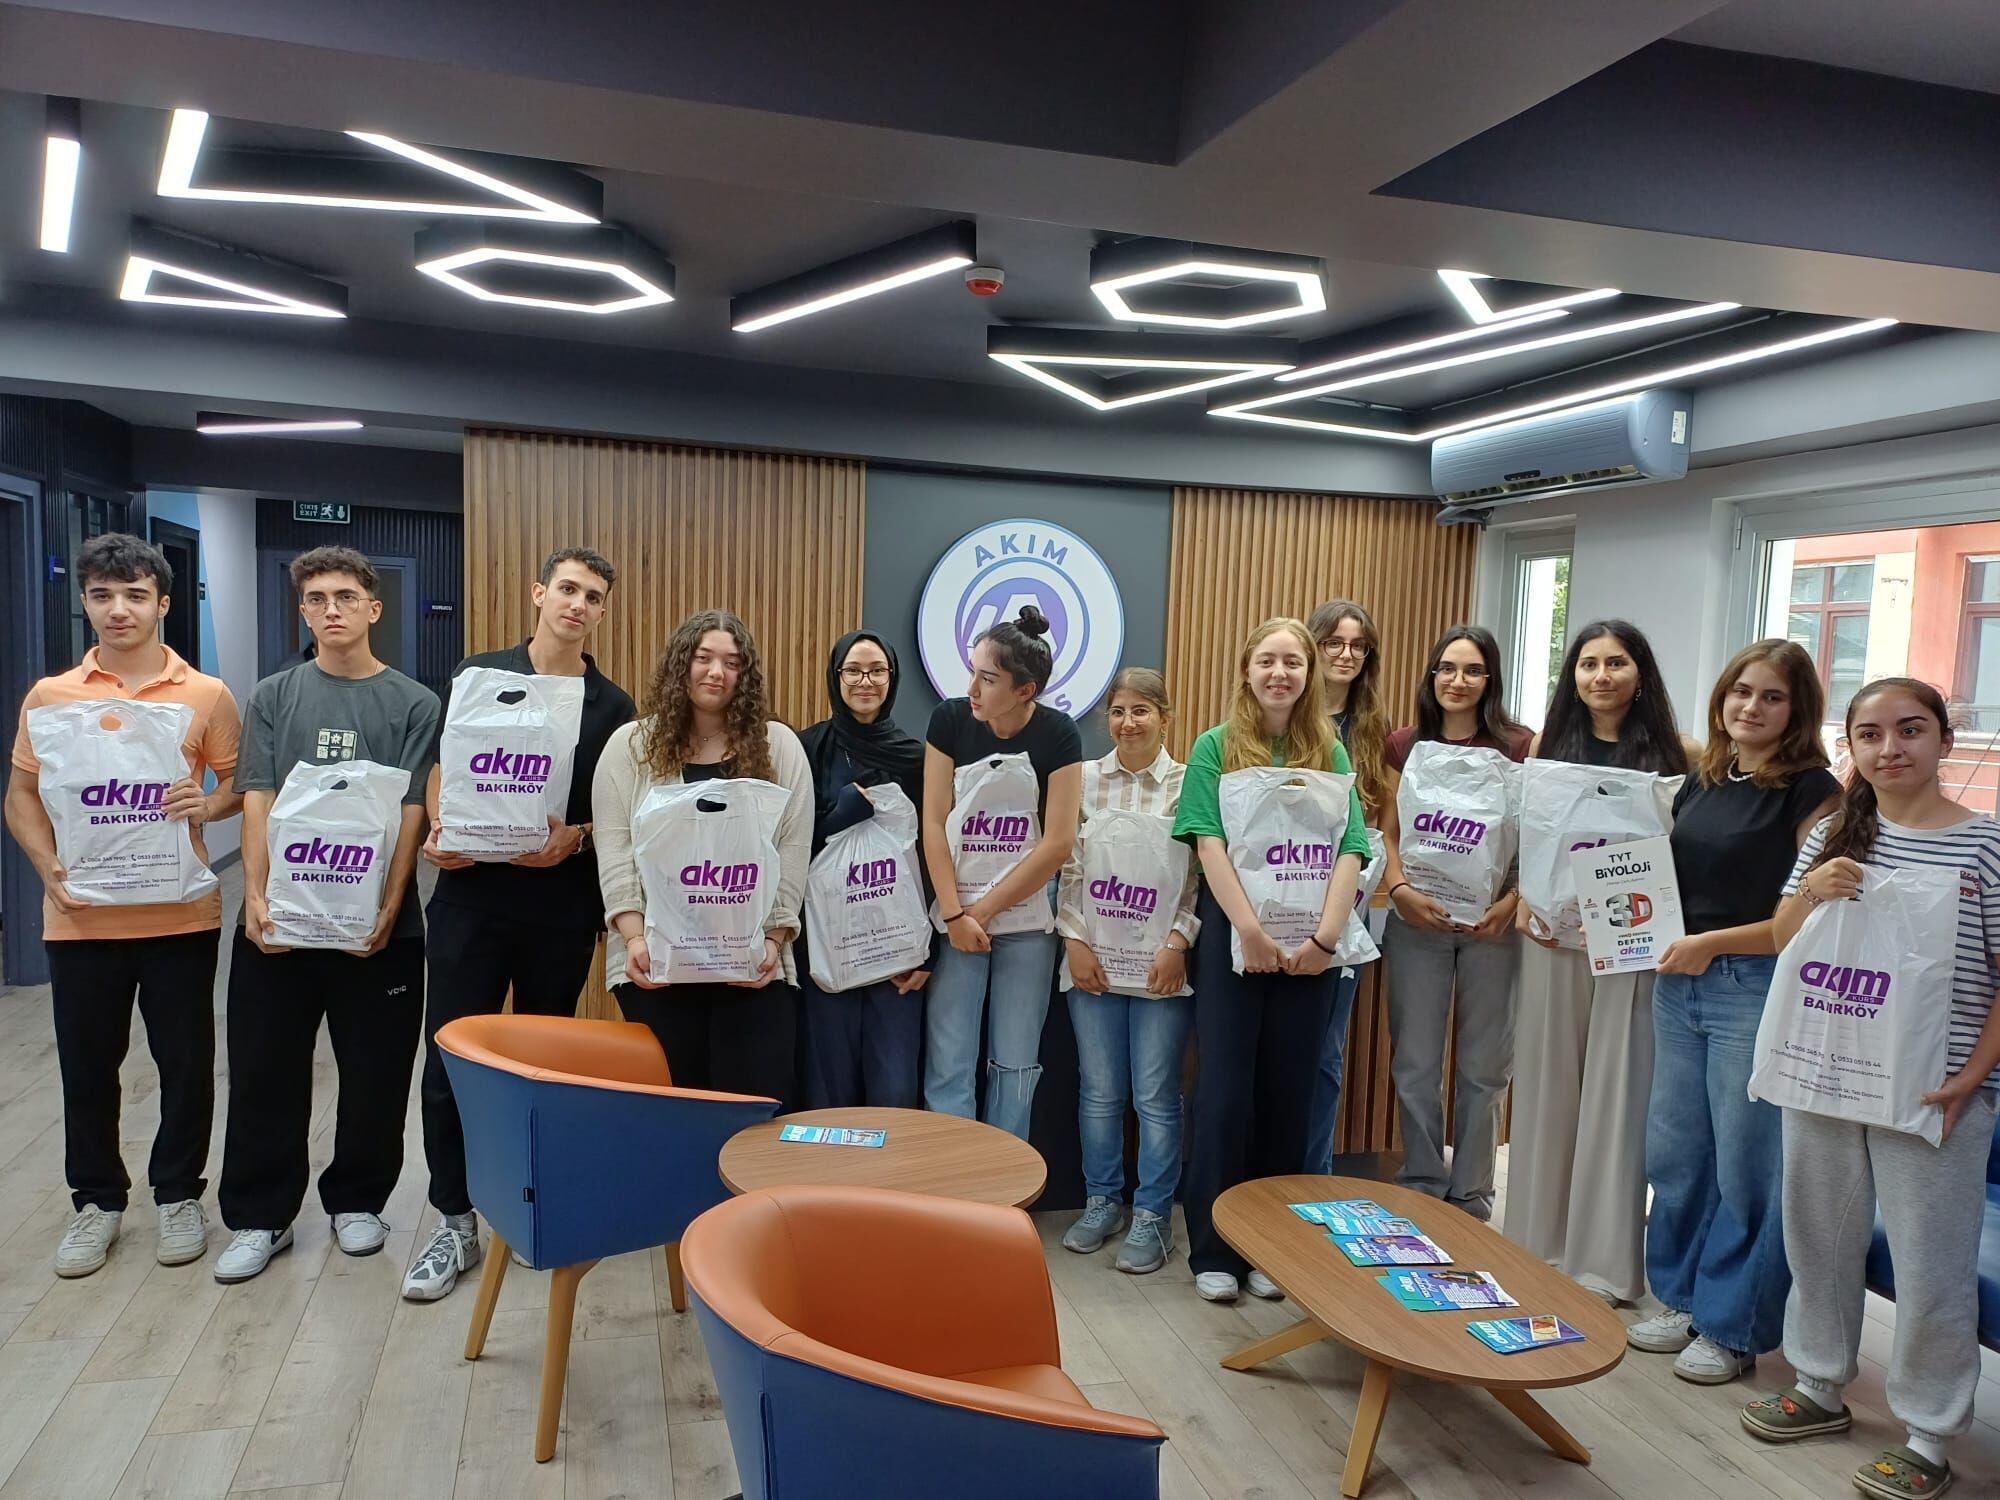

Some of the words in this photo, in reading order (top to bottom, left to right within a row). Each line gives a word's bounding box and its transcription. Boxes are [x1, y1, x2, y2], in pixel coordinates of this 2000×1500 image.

[974, 533, 1068, 568] AKIM
[477, 782, 544, 793] BAKIRKÖY
[90, 811, 169, 825] BAKIRKÖY
[962, 842, 1022, 853] BAKIRKÖY
[1608, 851, 1632, 864] TYT
[291, 873, 363, 884] BAKIRKÖY
[688, 892, 751, 905] BAKIRKÖY
[1605, 892, 1653, 929] 3D
[1617, 936, 1654, 946] DEFTER
[1853, 994, 1875, 1003] KURS
